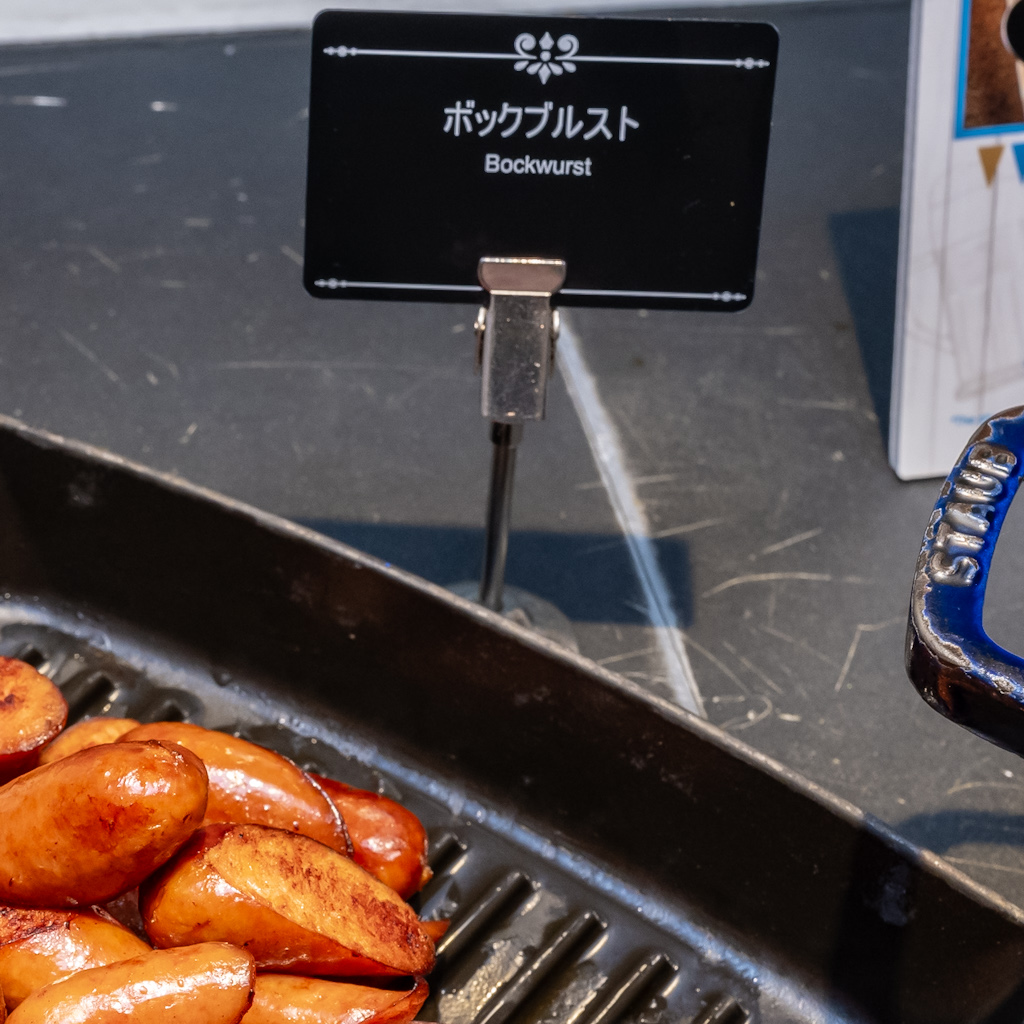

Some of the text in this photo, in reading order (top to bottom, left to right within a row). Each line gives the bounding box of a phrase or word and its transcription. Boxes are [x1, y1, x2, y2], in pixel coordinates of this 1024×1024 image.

[443, 100, 640, 142] ボックブルスト
[484, 153, 593, 177] Bockwurst
[929, 442, 1017, 587] STAUB
